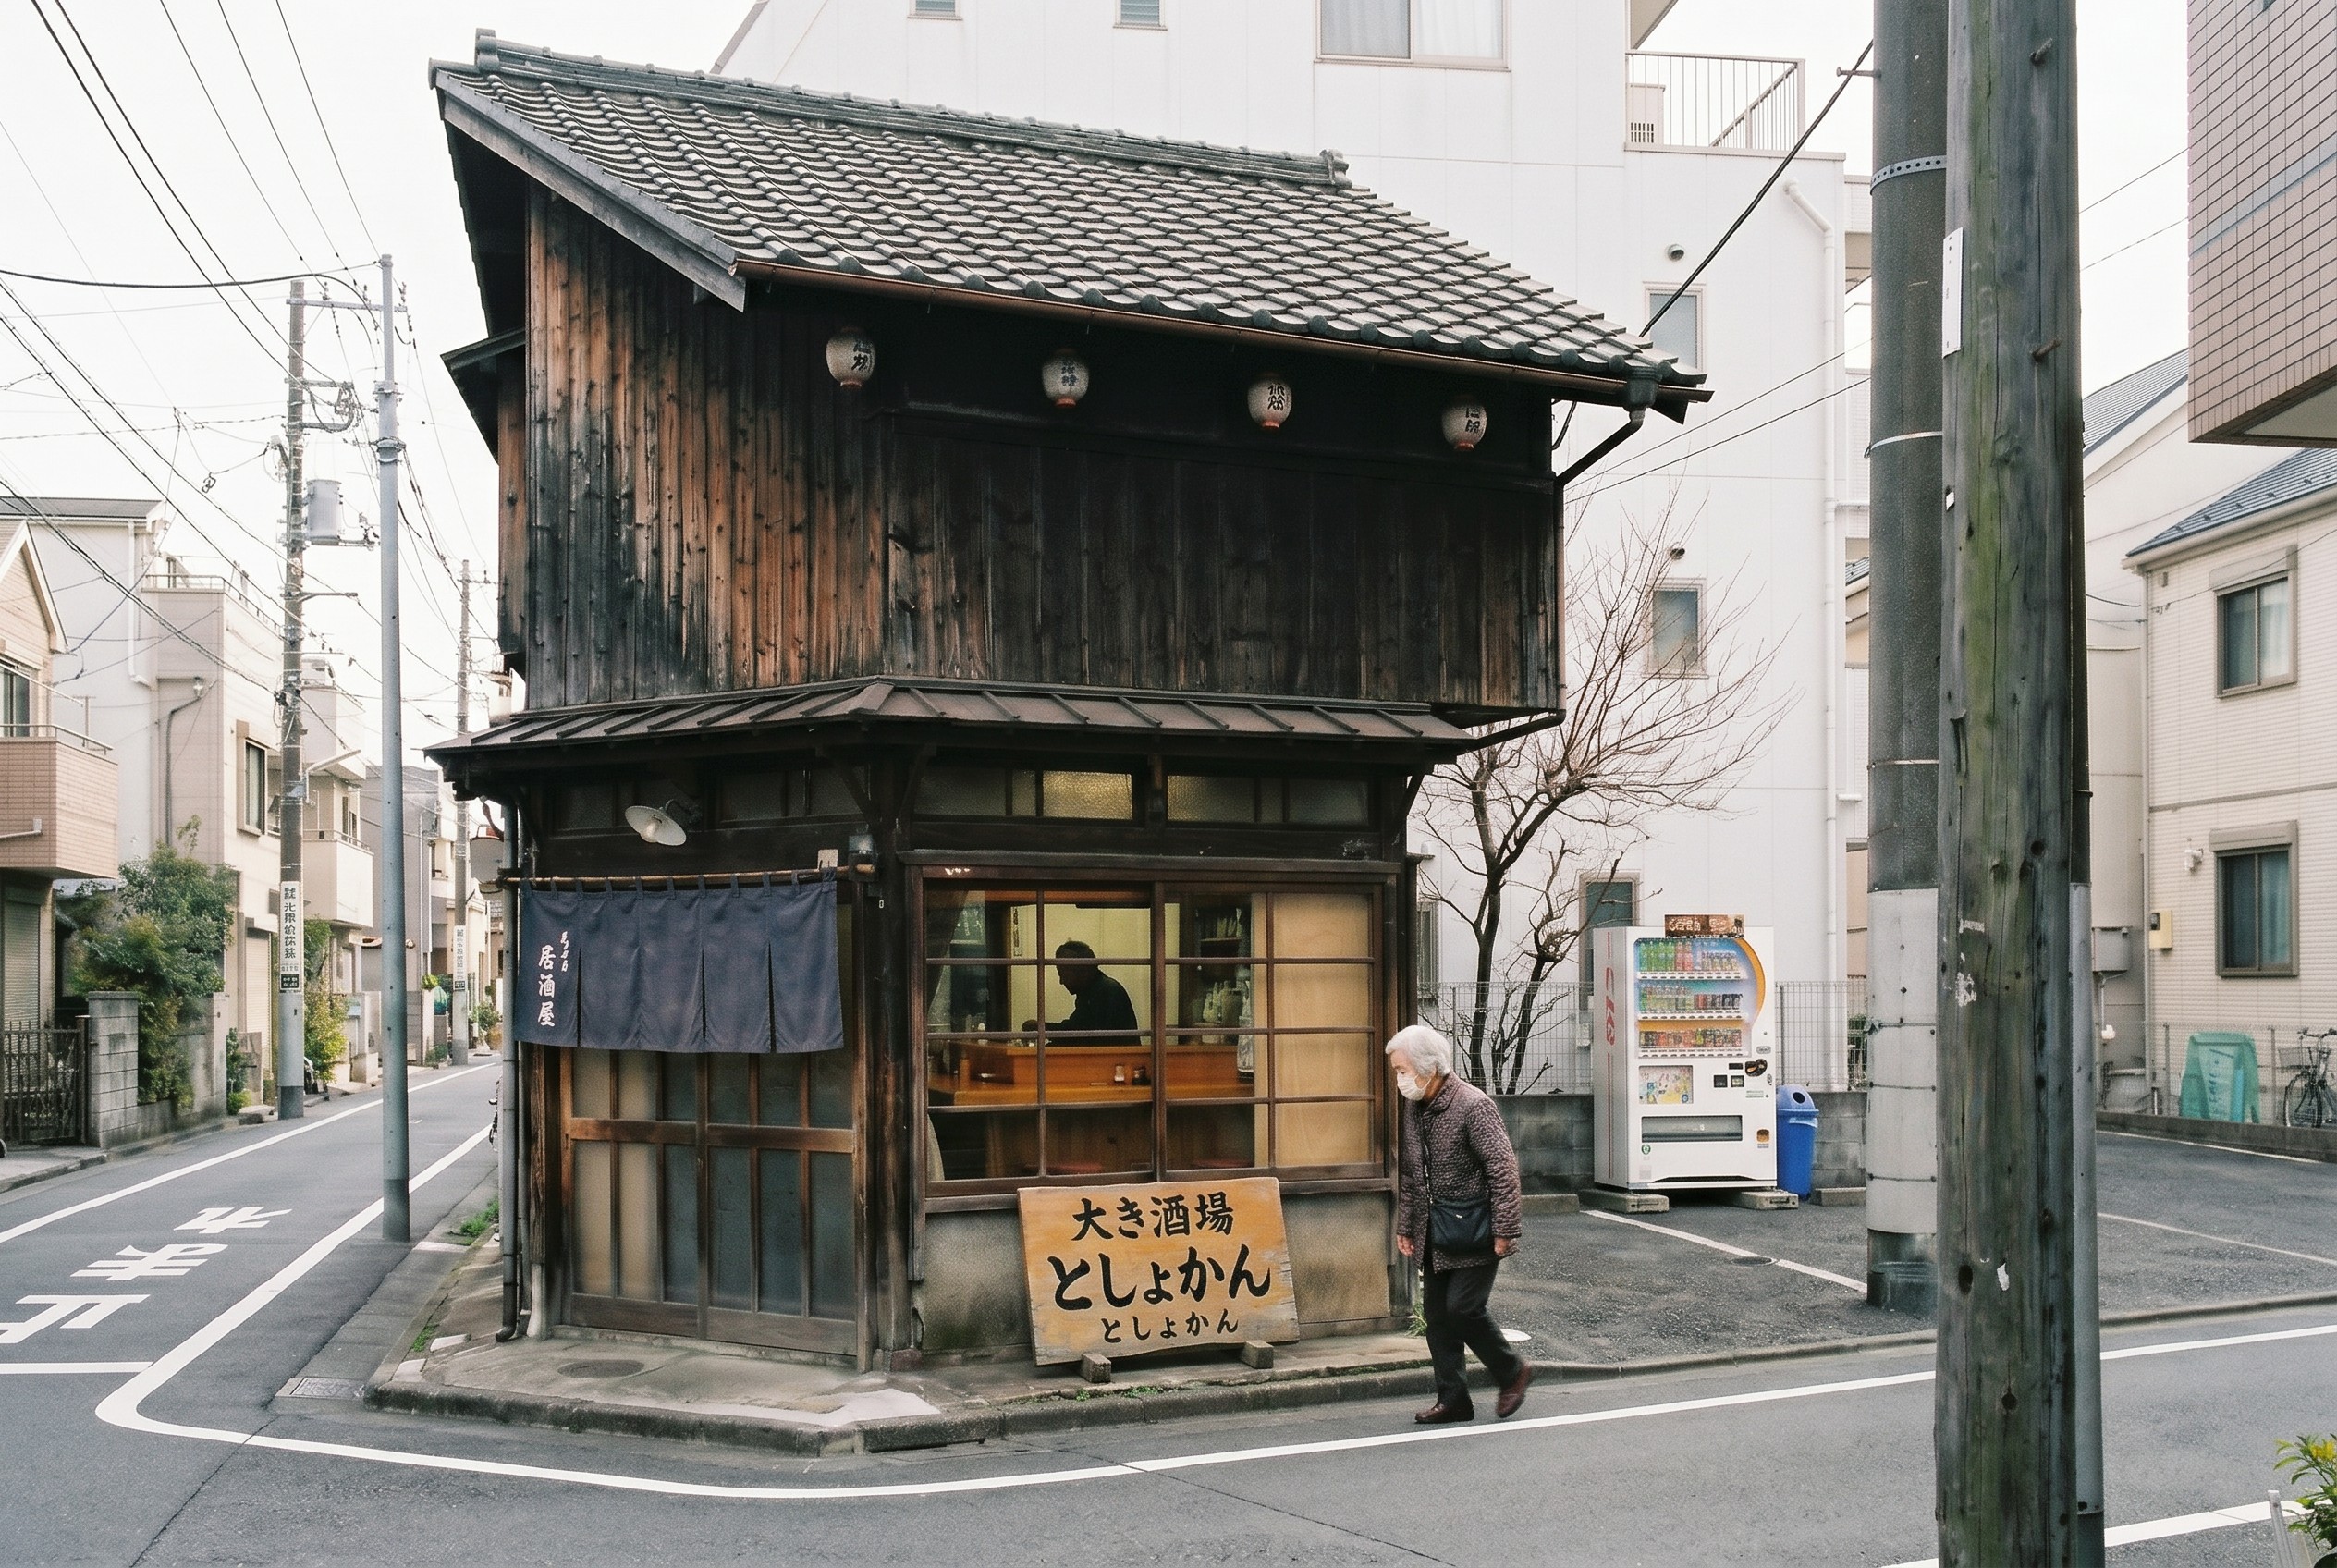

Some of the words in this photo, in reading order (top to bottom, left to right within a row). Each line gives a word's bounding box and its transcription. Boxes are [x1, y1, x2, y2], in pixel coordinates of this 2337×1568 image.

[538, 945, 556, 1027] 居酒屋
[1071, 1191, 1234, 1242] 大き酒場
[0, 1206, 293, 1344] 止まれ
[1046, 1243, 1271, 1311] としょかん
[1100, 1308, 1239, 1343] としょかん
